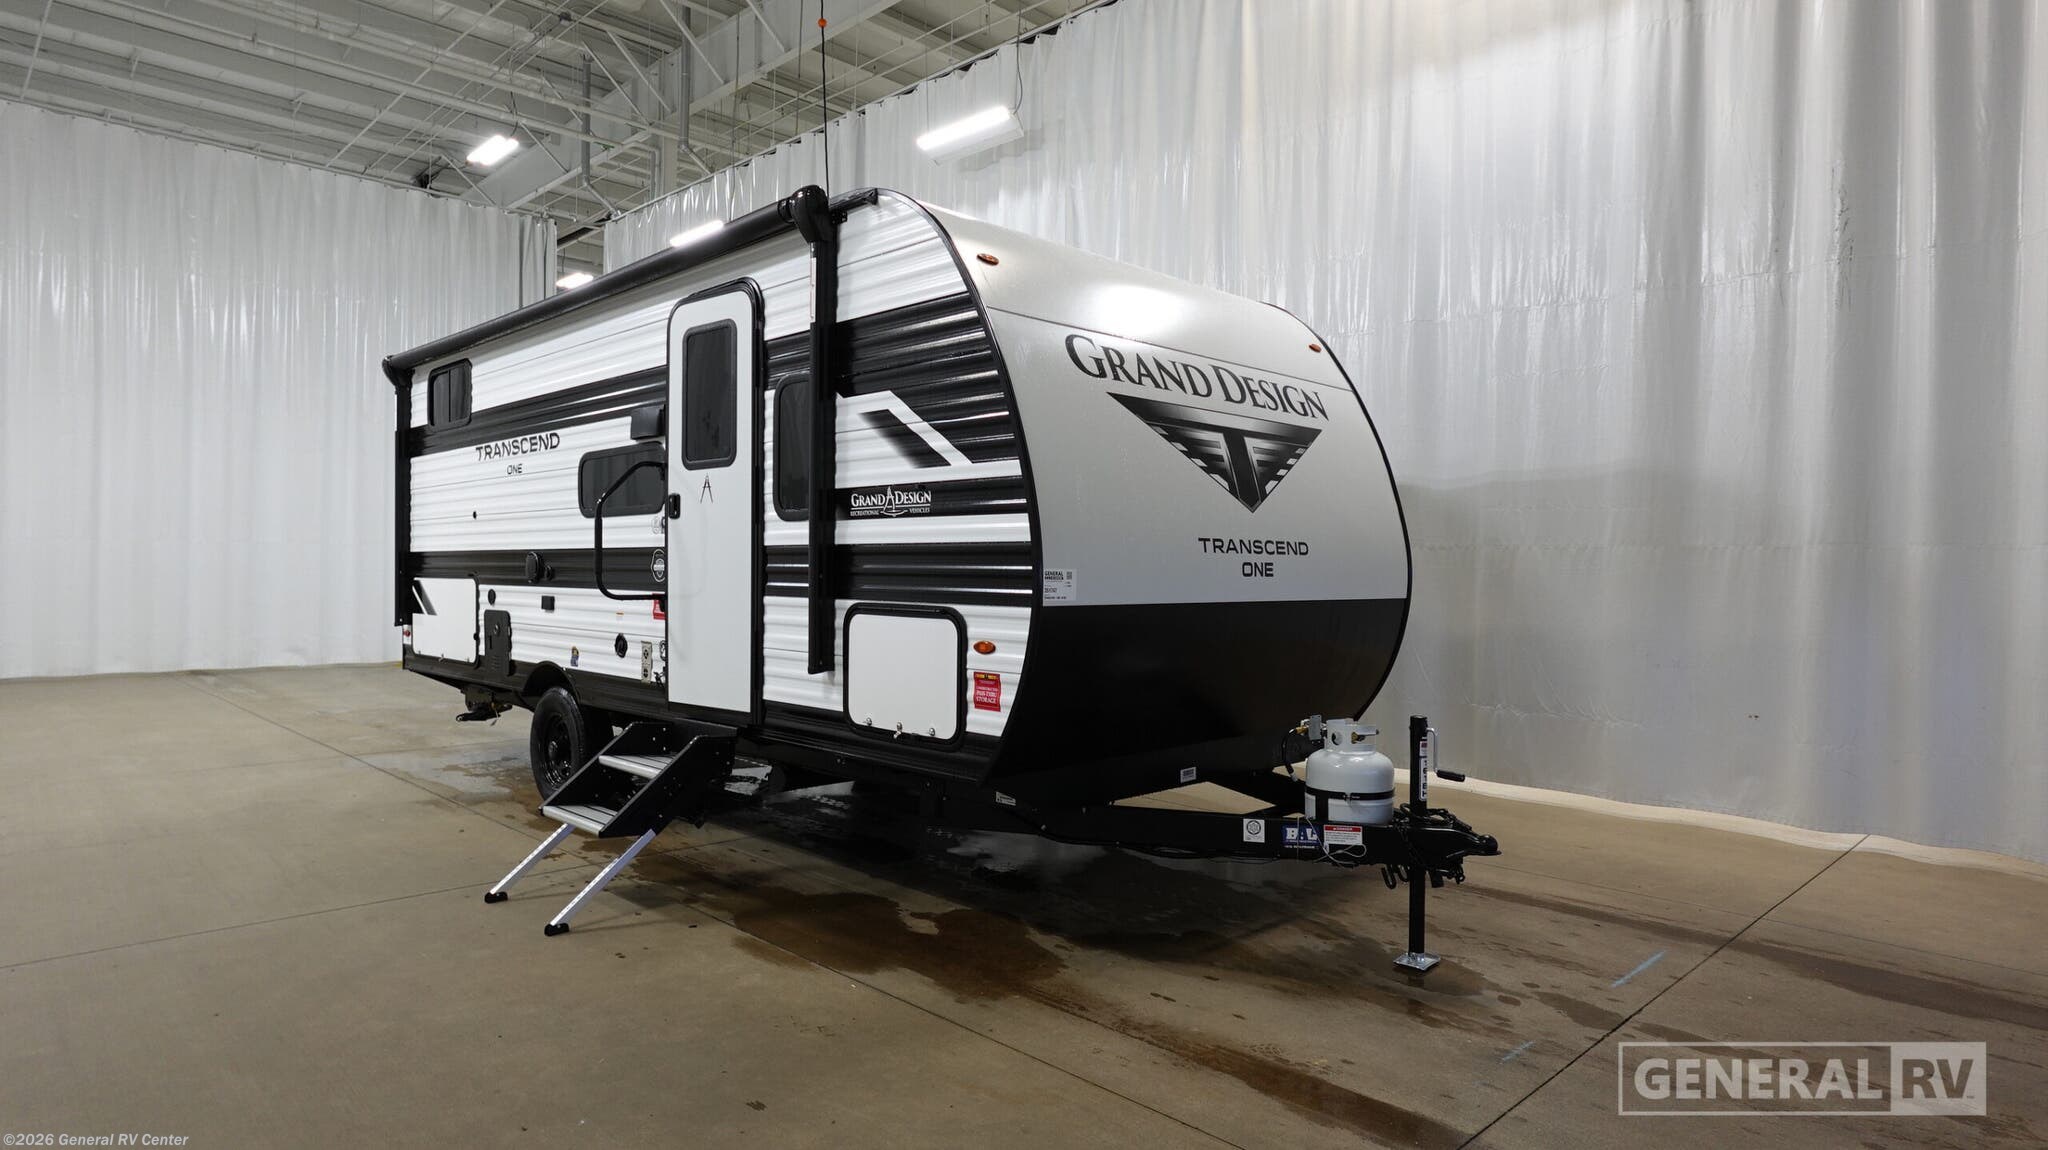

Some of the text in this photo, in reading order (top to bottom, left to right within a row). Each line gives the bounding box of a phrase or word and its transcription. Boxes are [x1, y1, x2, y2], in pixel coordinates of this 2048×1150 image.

[1065, 334, 1329, 421] GRAND DESIGN
[475, 432, 560, 461] TRANSCEND
[506, 463, 523, 475] ONE
[850, 490, 932, 507] GRAND DESIGN
[1198, 537, 1309, 556] TRANSCEND
[1242, 561, 1274, 578] ONE
